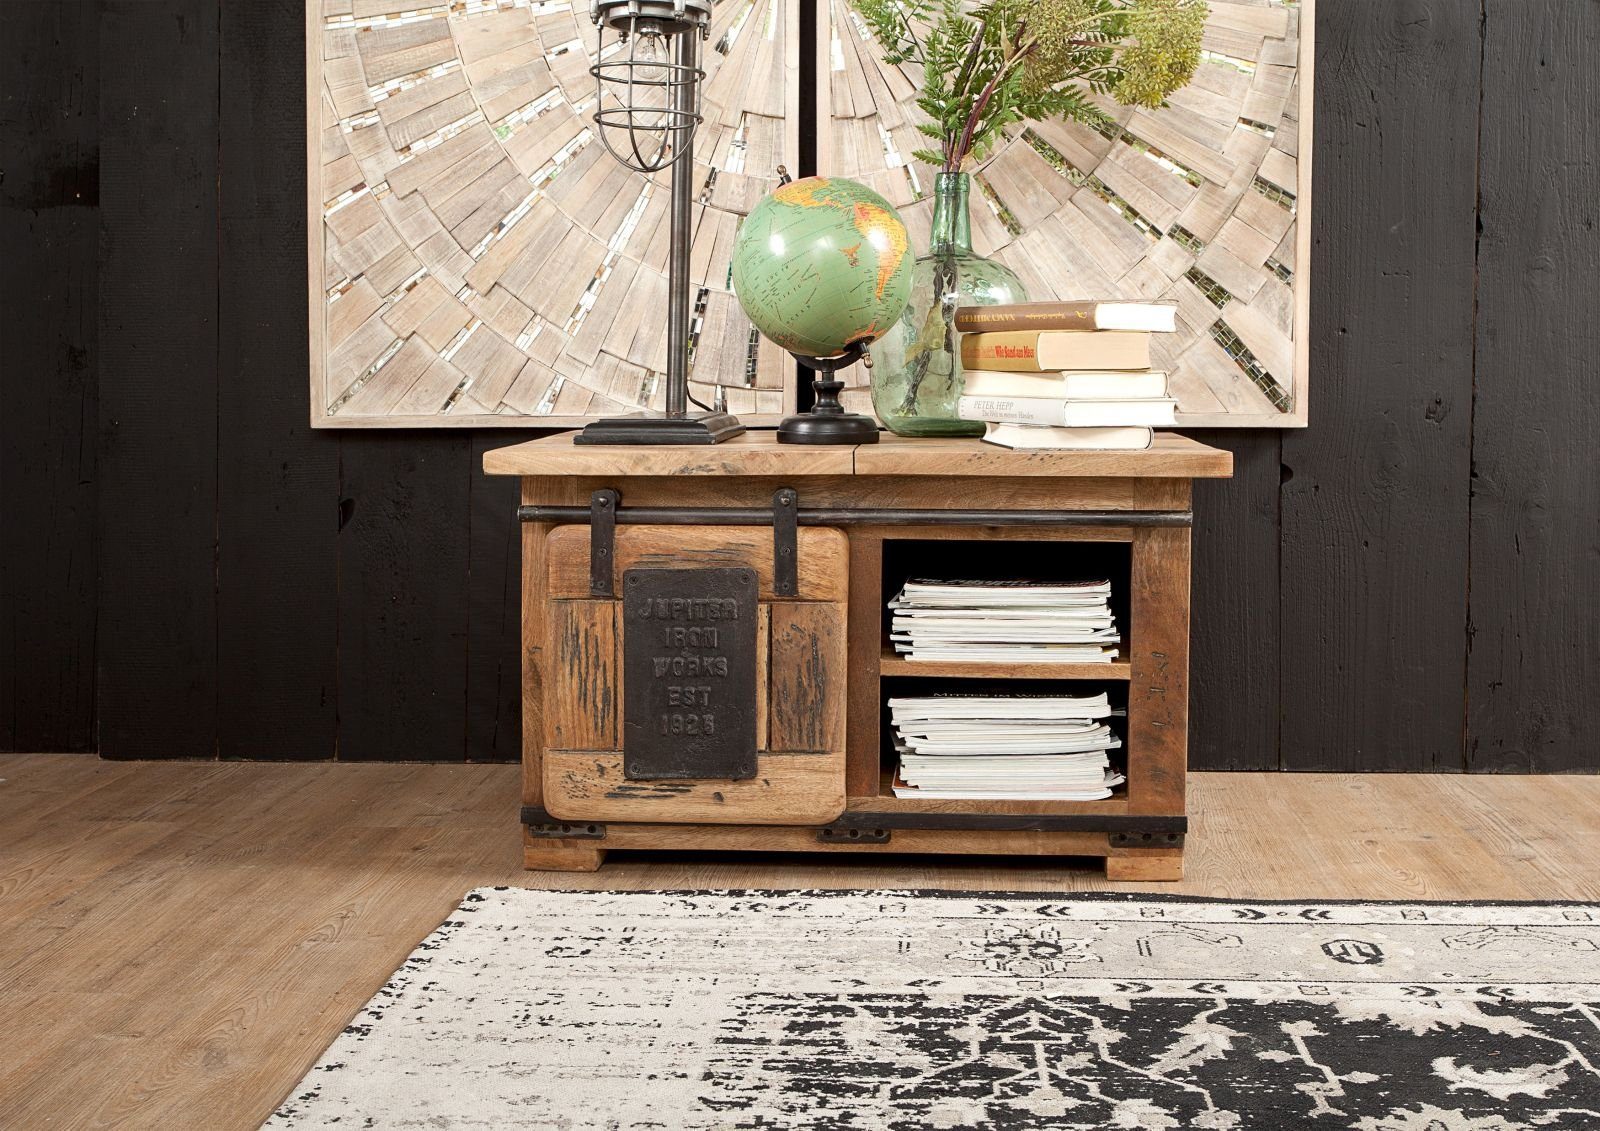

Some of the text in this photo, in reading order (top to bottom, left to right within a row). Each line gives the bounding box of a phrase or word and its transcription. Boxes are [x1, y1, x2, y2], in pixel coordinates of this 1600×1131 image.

[1004, 345, 1015, 358] Sand
[974, 401, 994, 410] PETER
[996, 402, 1014, 411] HEPP
[639, 597, 738, 621] JUPITER
[665, 626, 718, 649] IRON
[652, 656, 728, 678] WORKS
[667, 685, 712, 707] EST
